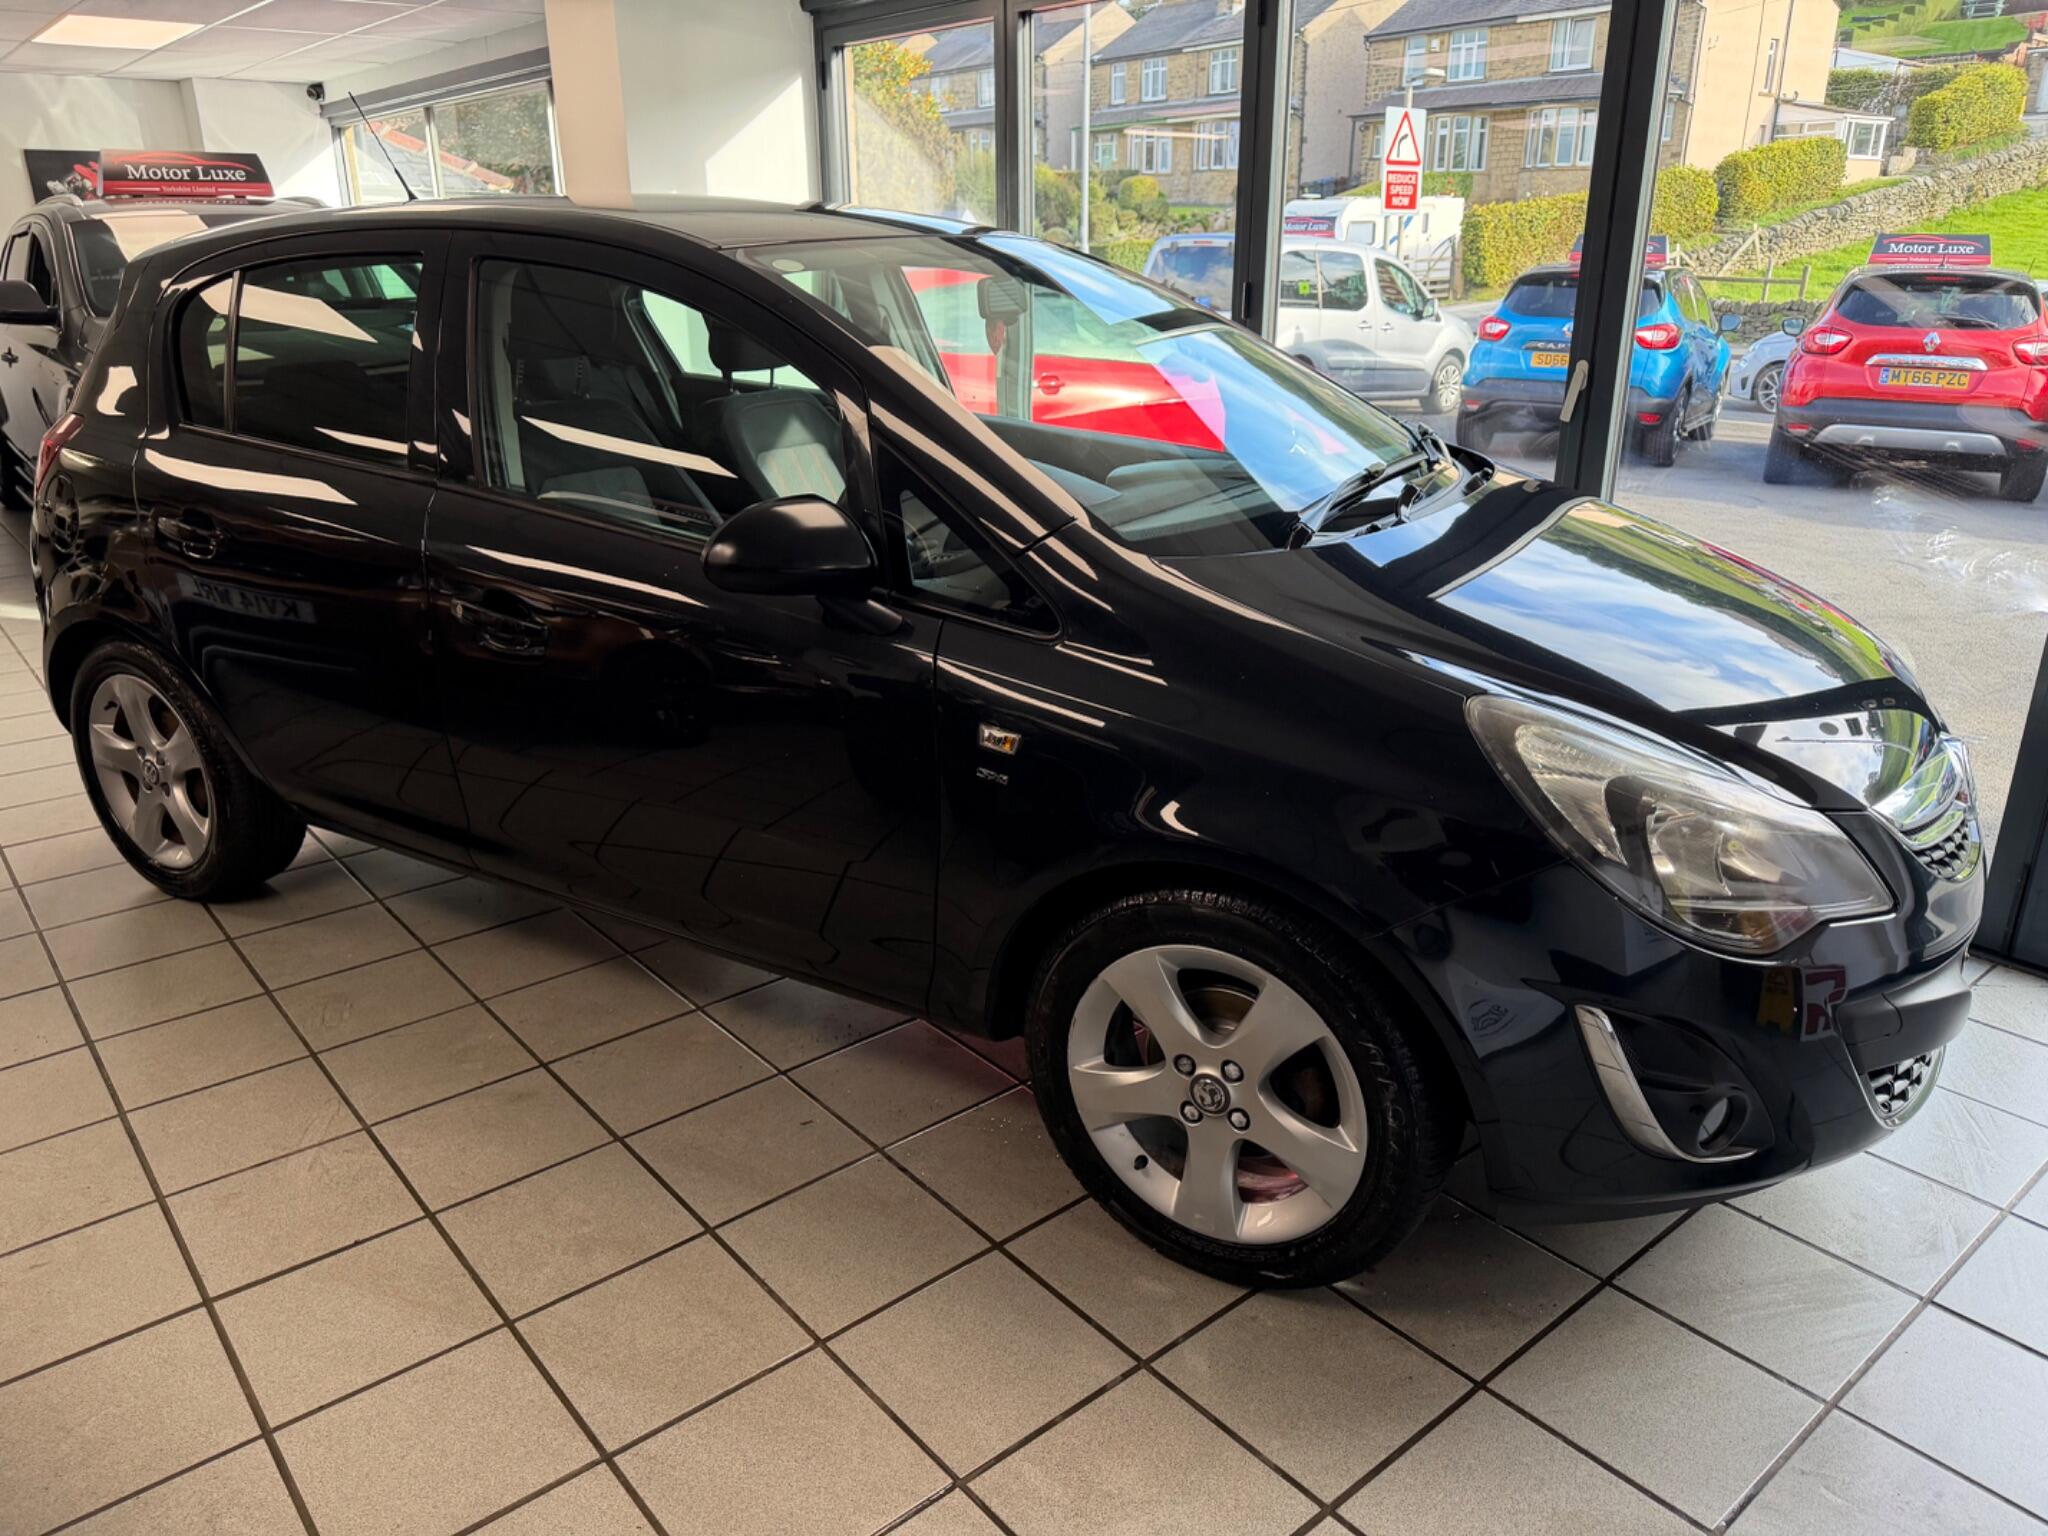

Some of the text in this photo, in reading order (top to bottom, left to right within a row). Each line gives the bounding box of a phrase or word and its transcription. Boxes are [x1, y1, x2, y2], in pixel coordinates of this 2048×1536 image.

[125, 164, 246, 181] Motor Luxe
[1388, 173, 1416, 184] REDUCE
[1390, 184, 1413, 195] SPEED
[1391, 195, 1410, 206] NOW
[1888, 243, 1975, 254] Motor Luxe
[1536, 353, 1568, 366] SD66
[1891, 368, 1968, 386] MT66 PZC
